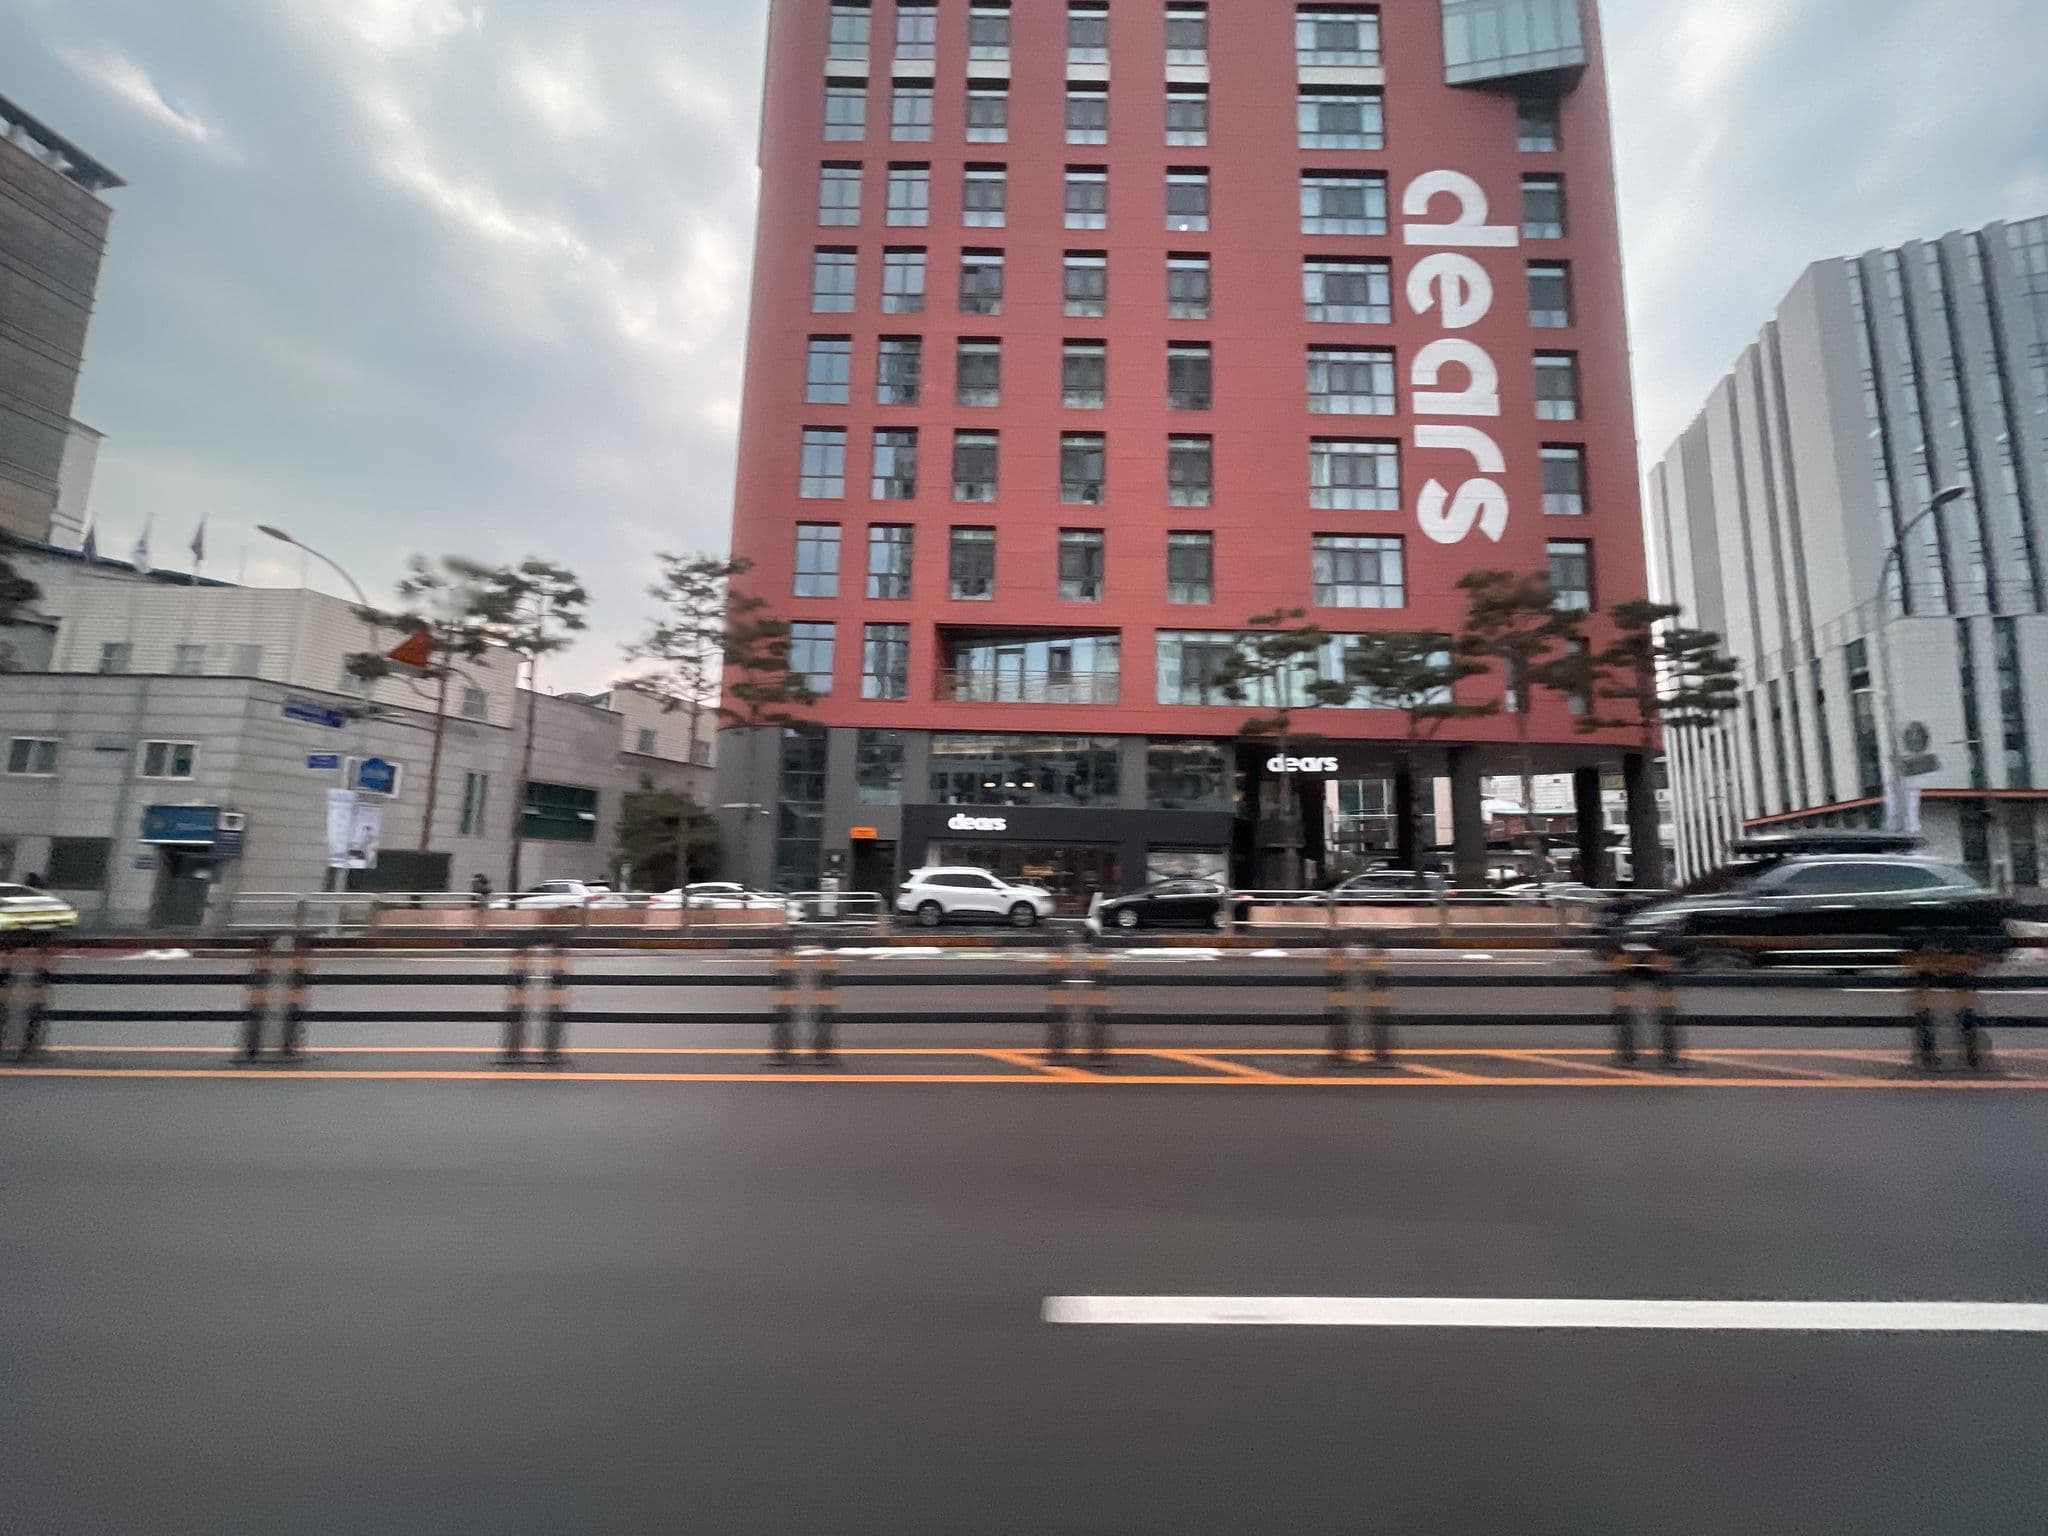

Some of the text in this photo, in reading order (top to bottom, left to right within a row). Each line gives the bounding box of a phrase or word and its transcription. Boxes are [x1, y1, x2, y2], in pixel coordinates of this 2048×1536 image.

[1402, 170, 1519, 544] dears
[1266, 754, 1339, 774] dears
[947, 813, 1007, 831] dears
